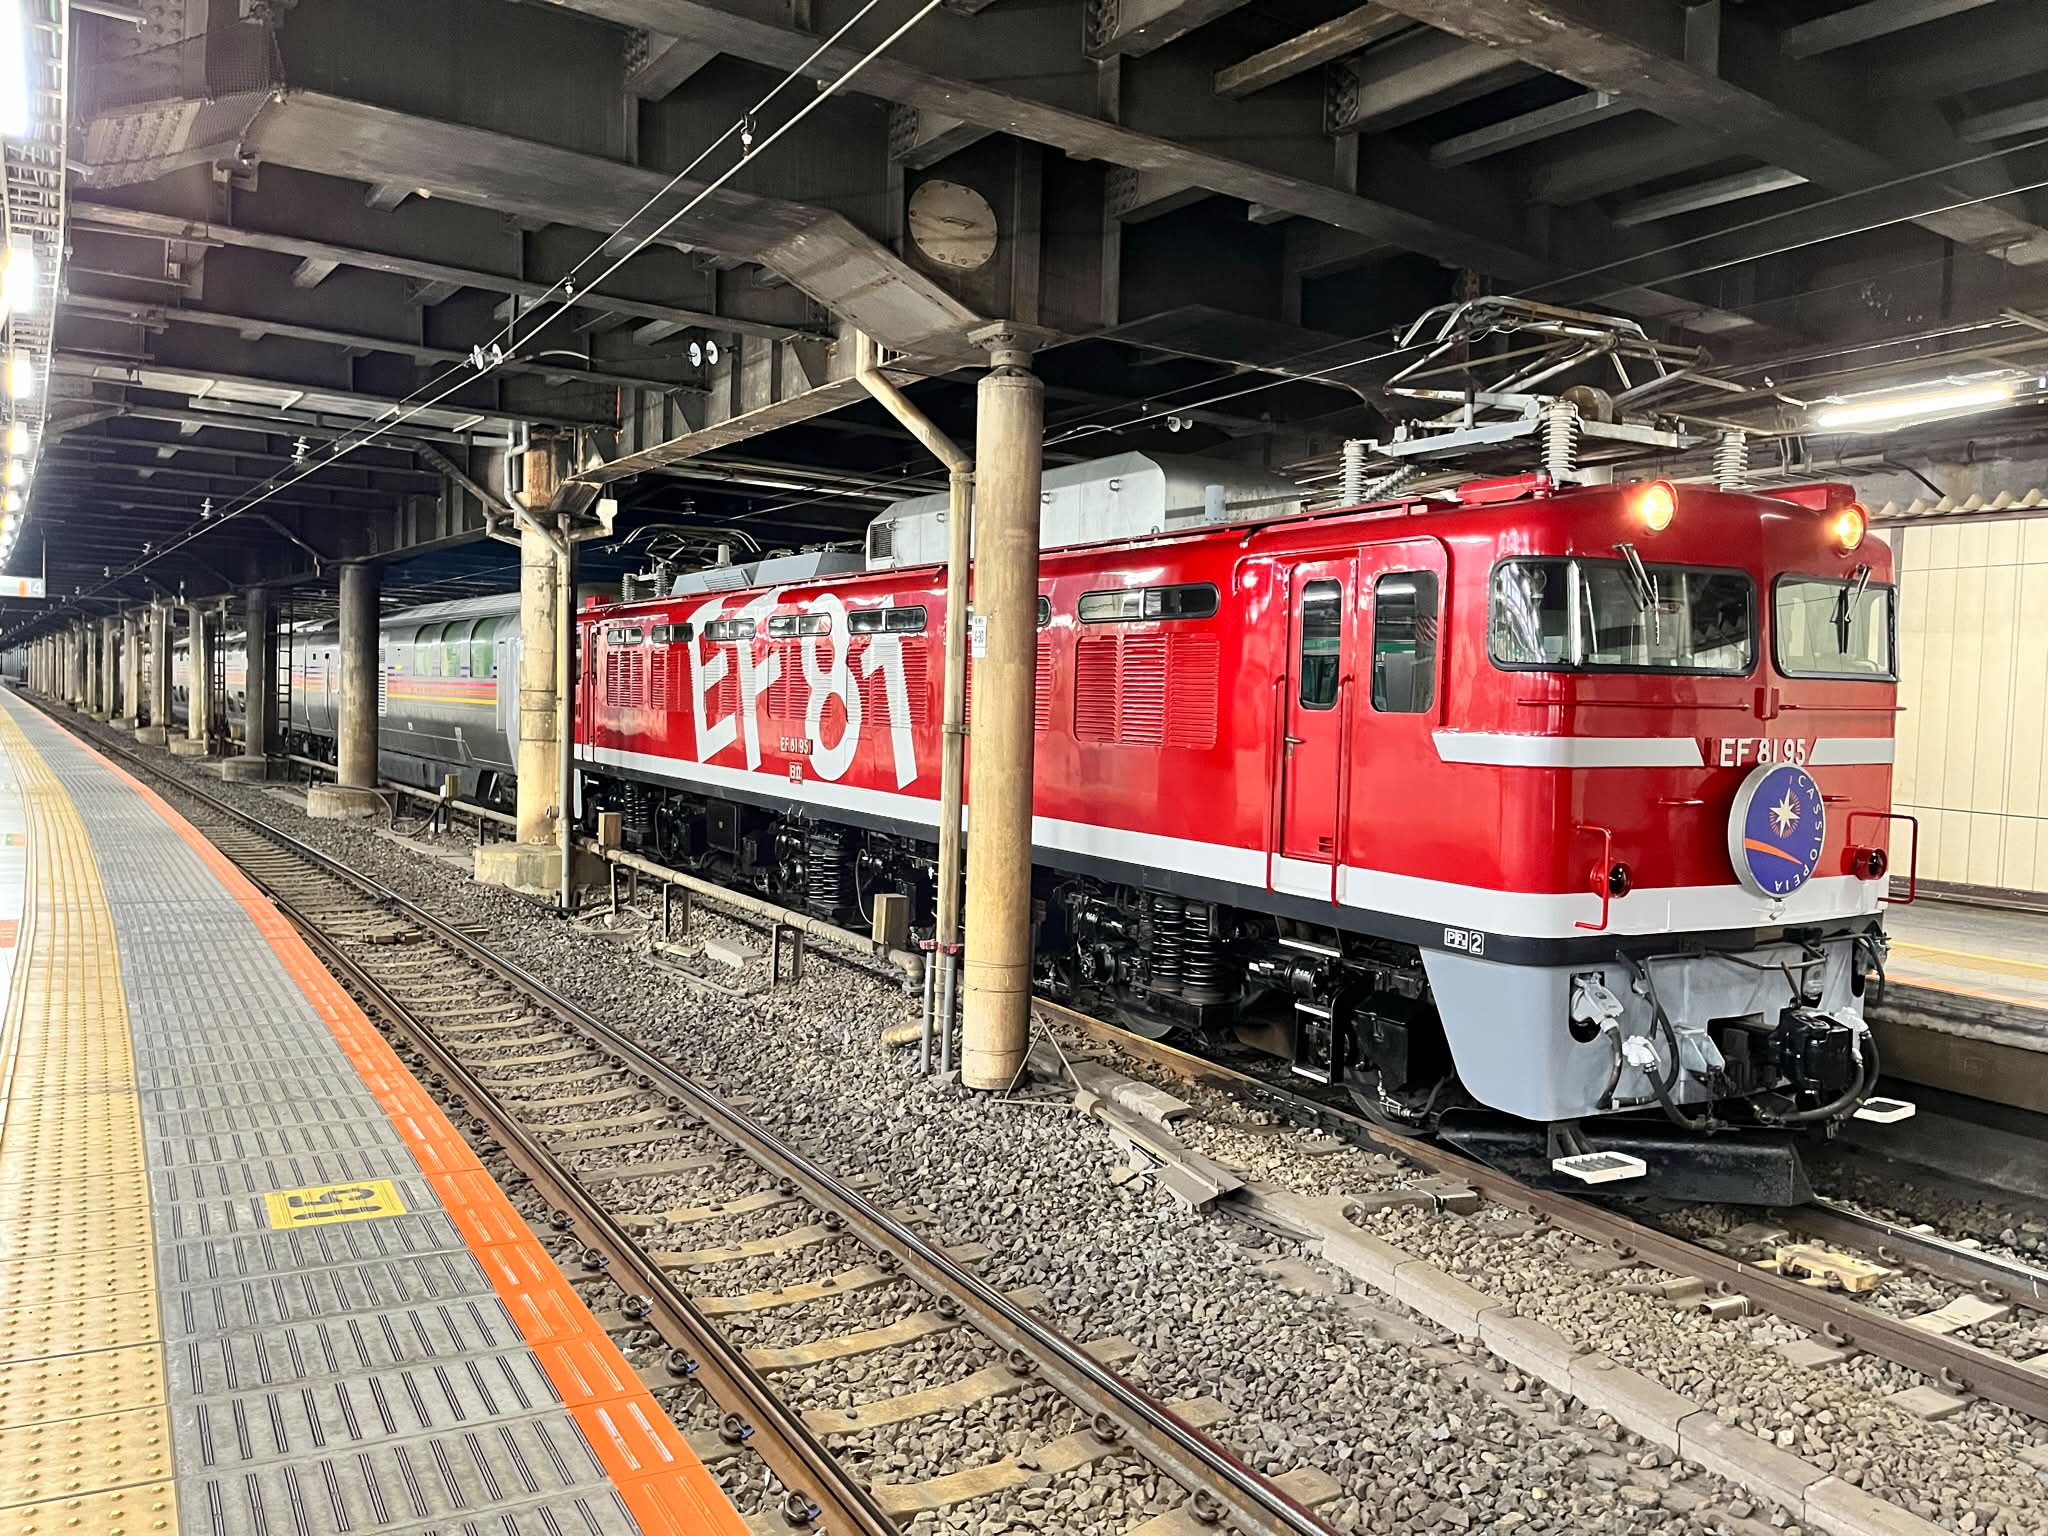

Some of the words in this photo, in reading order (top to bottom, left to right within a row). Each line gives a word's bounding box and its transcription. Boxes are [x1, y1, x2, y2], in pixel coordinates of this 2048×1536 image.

[688, 587, 918, 790] EF81
[1774, 775, 1823, 892] CASSIOPEIA
[1471, 933, 1482, 953] 2
